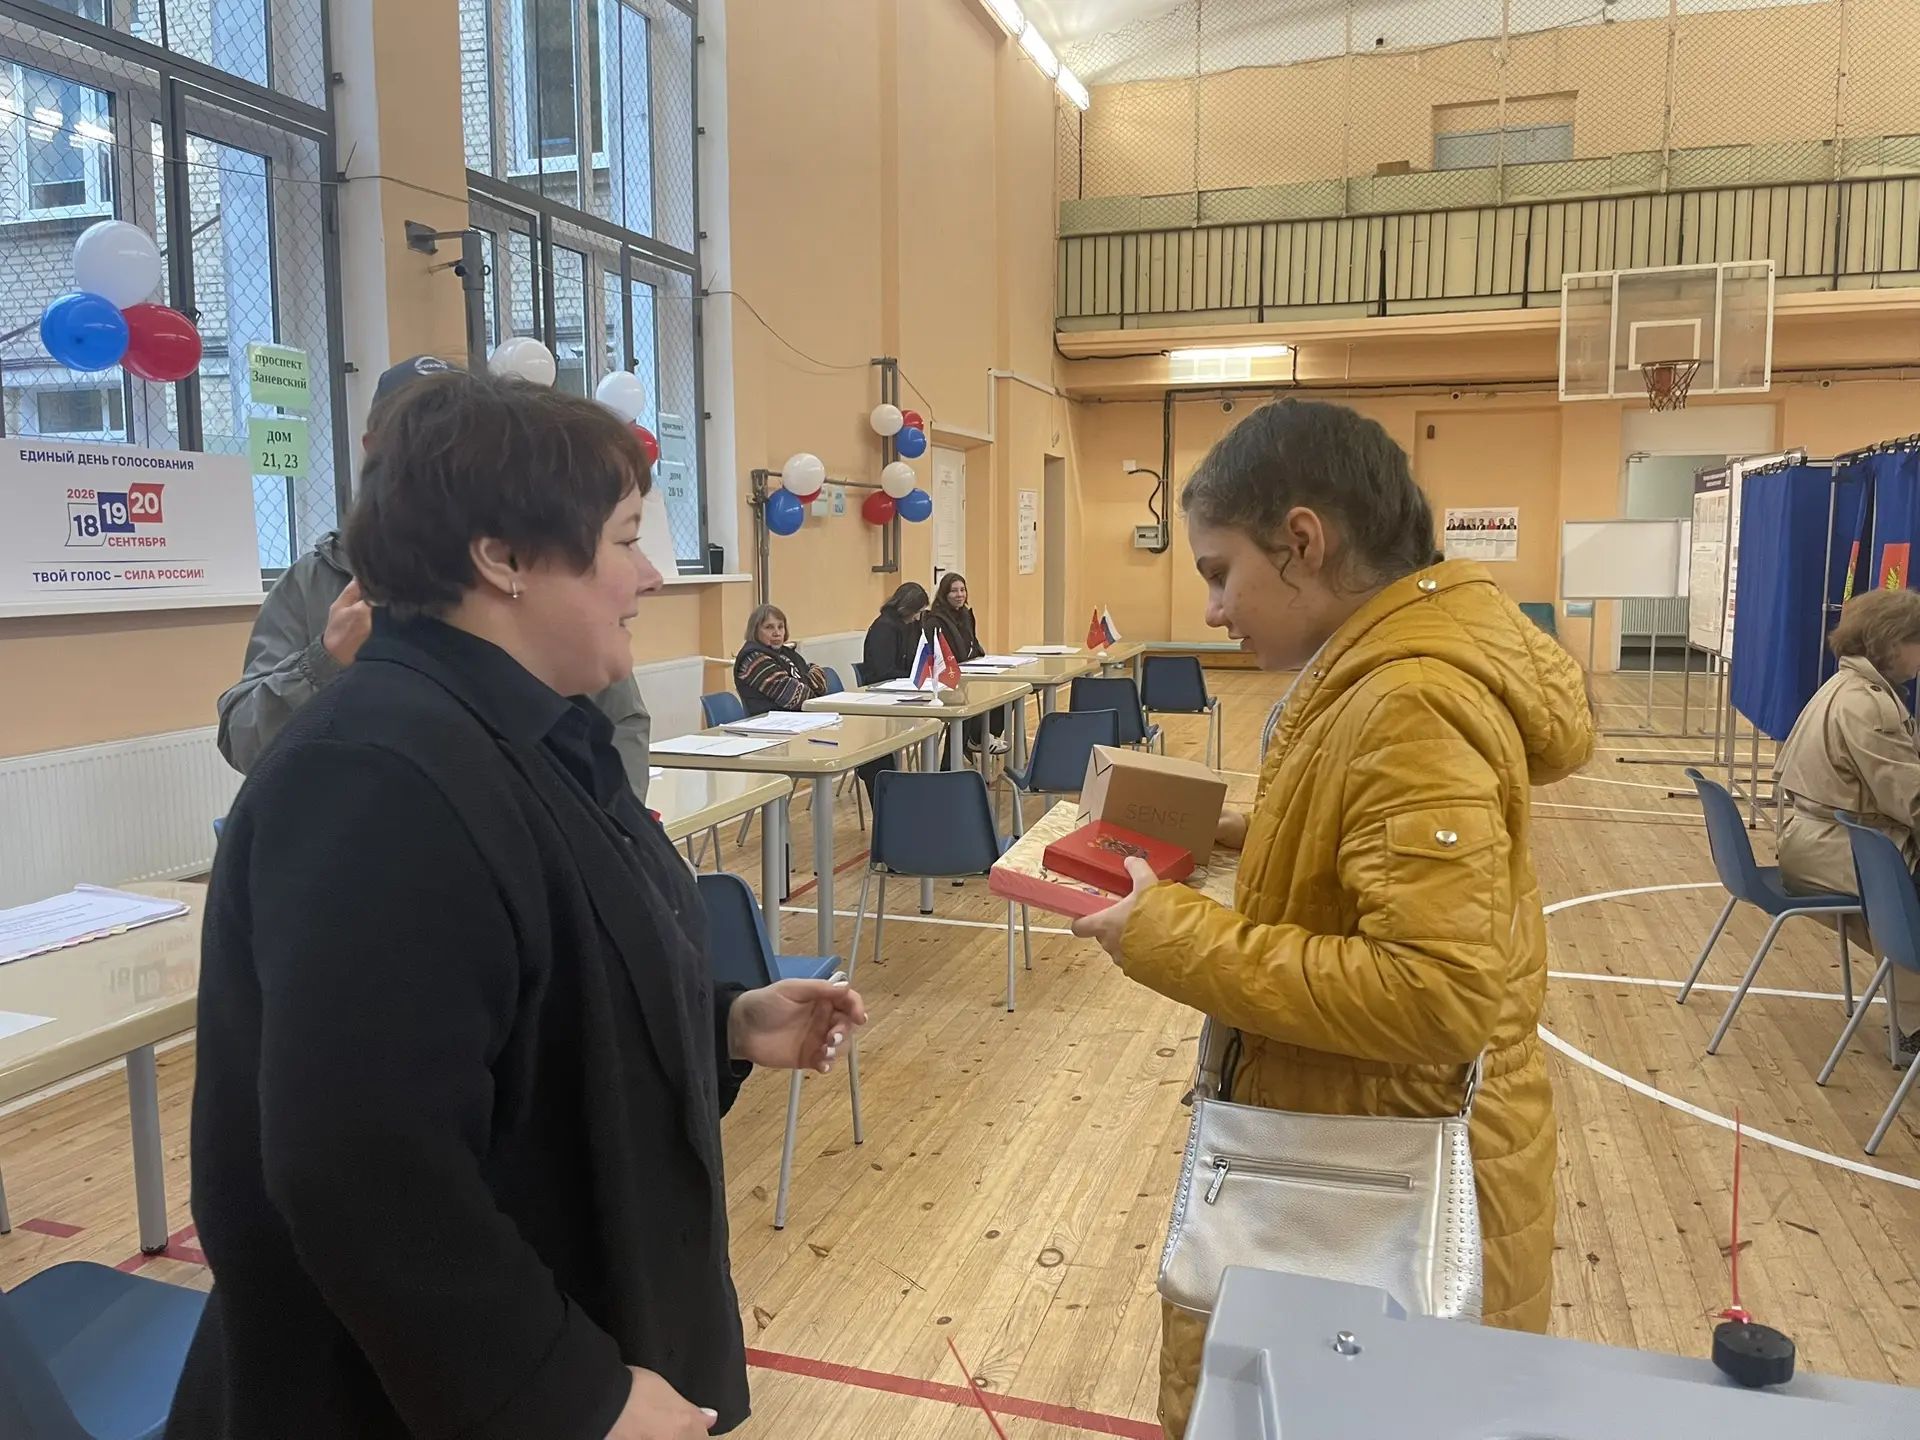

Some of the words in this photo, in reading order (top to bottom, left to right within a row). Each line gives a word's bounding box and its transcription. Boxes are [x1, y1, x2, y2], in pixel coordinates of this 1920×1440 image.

[254, 354, 302, 370] проспект
[252, 370, 307, 389] Заневский
[266, 430, 292, 444] дом
[20, 450, 75, 463] ЕДИНЫЙ
[78, 454, 109, 466] ДЕНЬ
[112, 457, 194, 470] ГОЛОСОВАНИЯ
[262, 452, 281, 470] 21,
[284, 453, 298, 469] 23
[67, 488, 96, 499] 2026
[73, 514, 100, 537] 18
[101, 501, 128, 526] 19
[130, 492, 160, 515] 20
[108, 536, 167, 548] СЕНТЯБРЯ
[33, 569, 68, 583] ТВОЙ
[71, 570, 112, 582] ГОЛОС
[124, 569, 156, 581] СИЛА
[158, 568, 205, 580] РОССИИ!
[1126, 803, 1193, 830] SENSE
